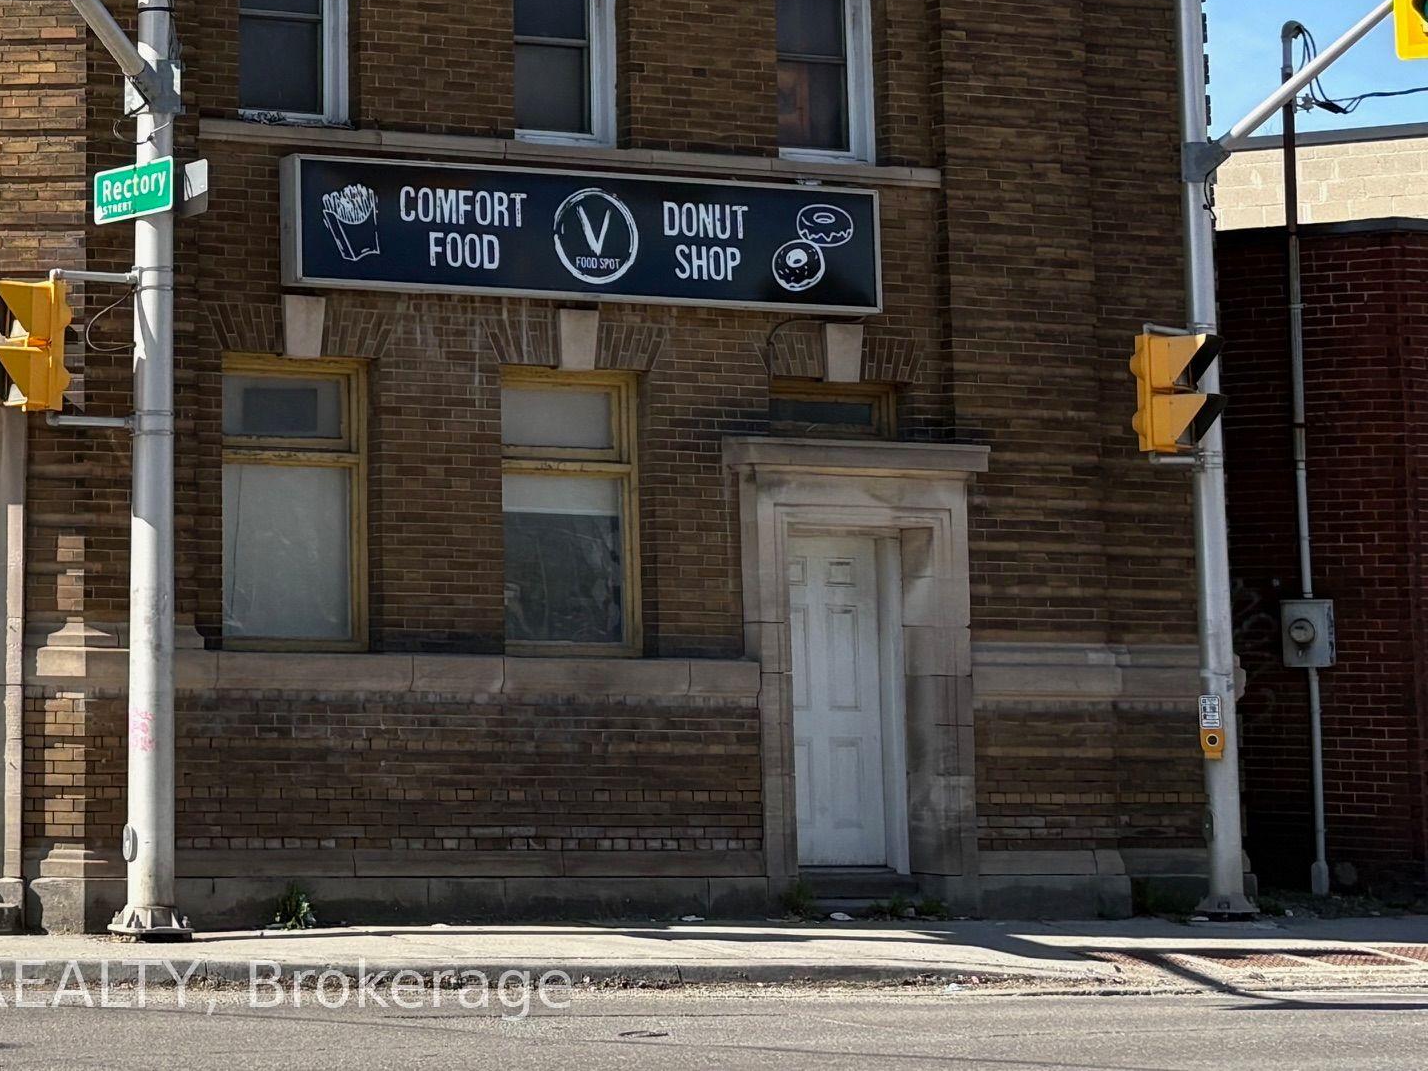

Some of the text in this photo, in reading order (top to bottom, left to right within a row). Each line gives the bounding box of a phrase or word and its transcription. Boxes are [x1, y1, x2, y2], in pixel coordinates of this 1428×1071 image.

[102, 170, 166, 203] Rectory
[102, 201, 132, 216] STREET
[399, 186, 527, 228] COMFORT
[663, 201, 748, 240] DONUT
[577, 205, 611, 256] V
[429, 231, 500, 270] FOOD
[575, 256, 621, 270] FOOD SPOT
[674, 245, 741, 281] SHOP
